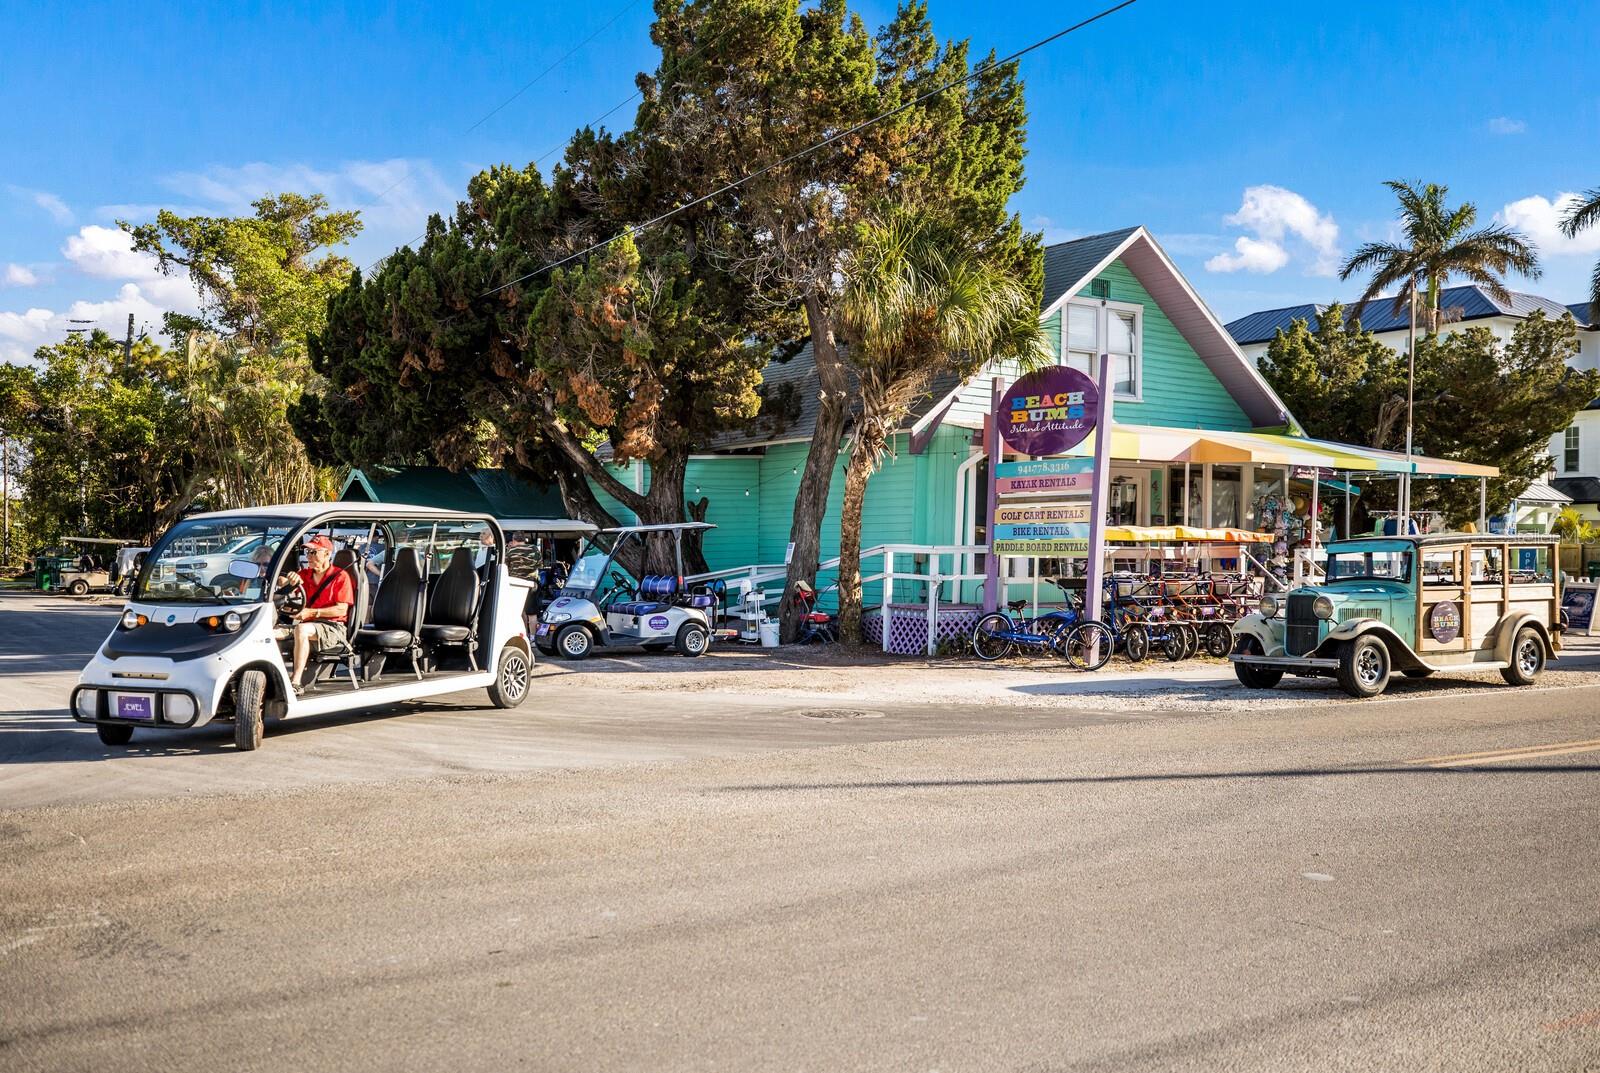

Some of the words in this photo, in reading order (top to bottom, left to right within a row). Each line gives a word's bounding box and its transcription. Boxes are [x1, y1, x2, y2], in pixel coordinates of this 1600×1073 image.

[1011, 391, 1085, 410] BEACH
[1010, 405, 1085, 423] BUMS
[1010, 421, 1041, 434] Island
[1041, 419, 1085, 431] Attitude
[1011, 479, 1038, 489] KAYAK
[1039, 477, 1077, 488] RENTALS
[1001, 511, 1022, 520] GOLF
[1023, 511, 1045, 520] CART
[1046, 509, 1084, 519] RENTALS
[1012, 527, 1031, 536] BIKE
[1032, 526, 1069, 535] RENTALS
[996, 543, 1025, 552] PADDLE
[1026, 543, 1052, 551] BOARD
[1053, 542, 1088, 551] RENTALS
